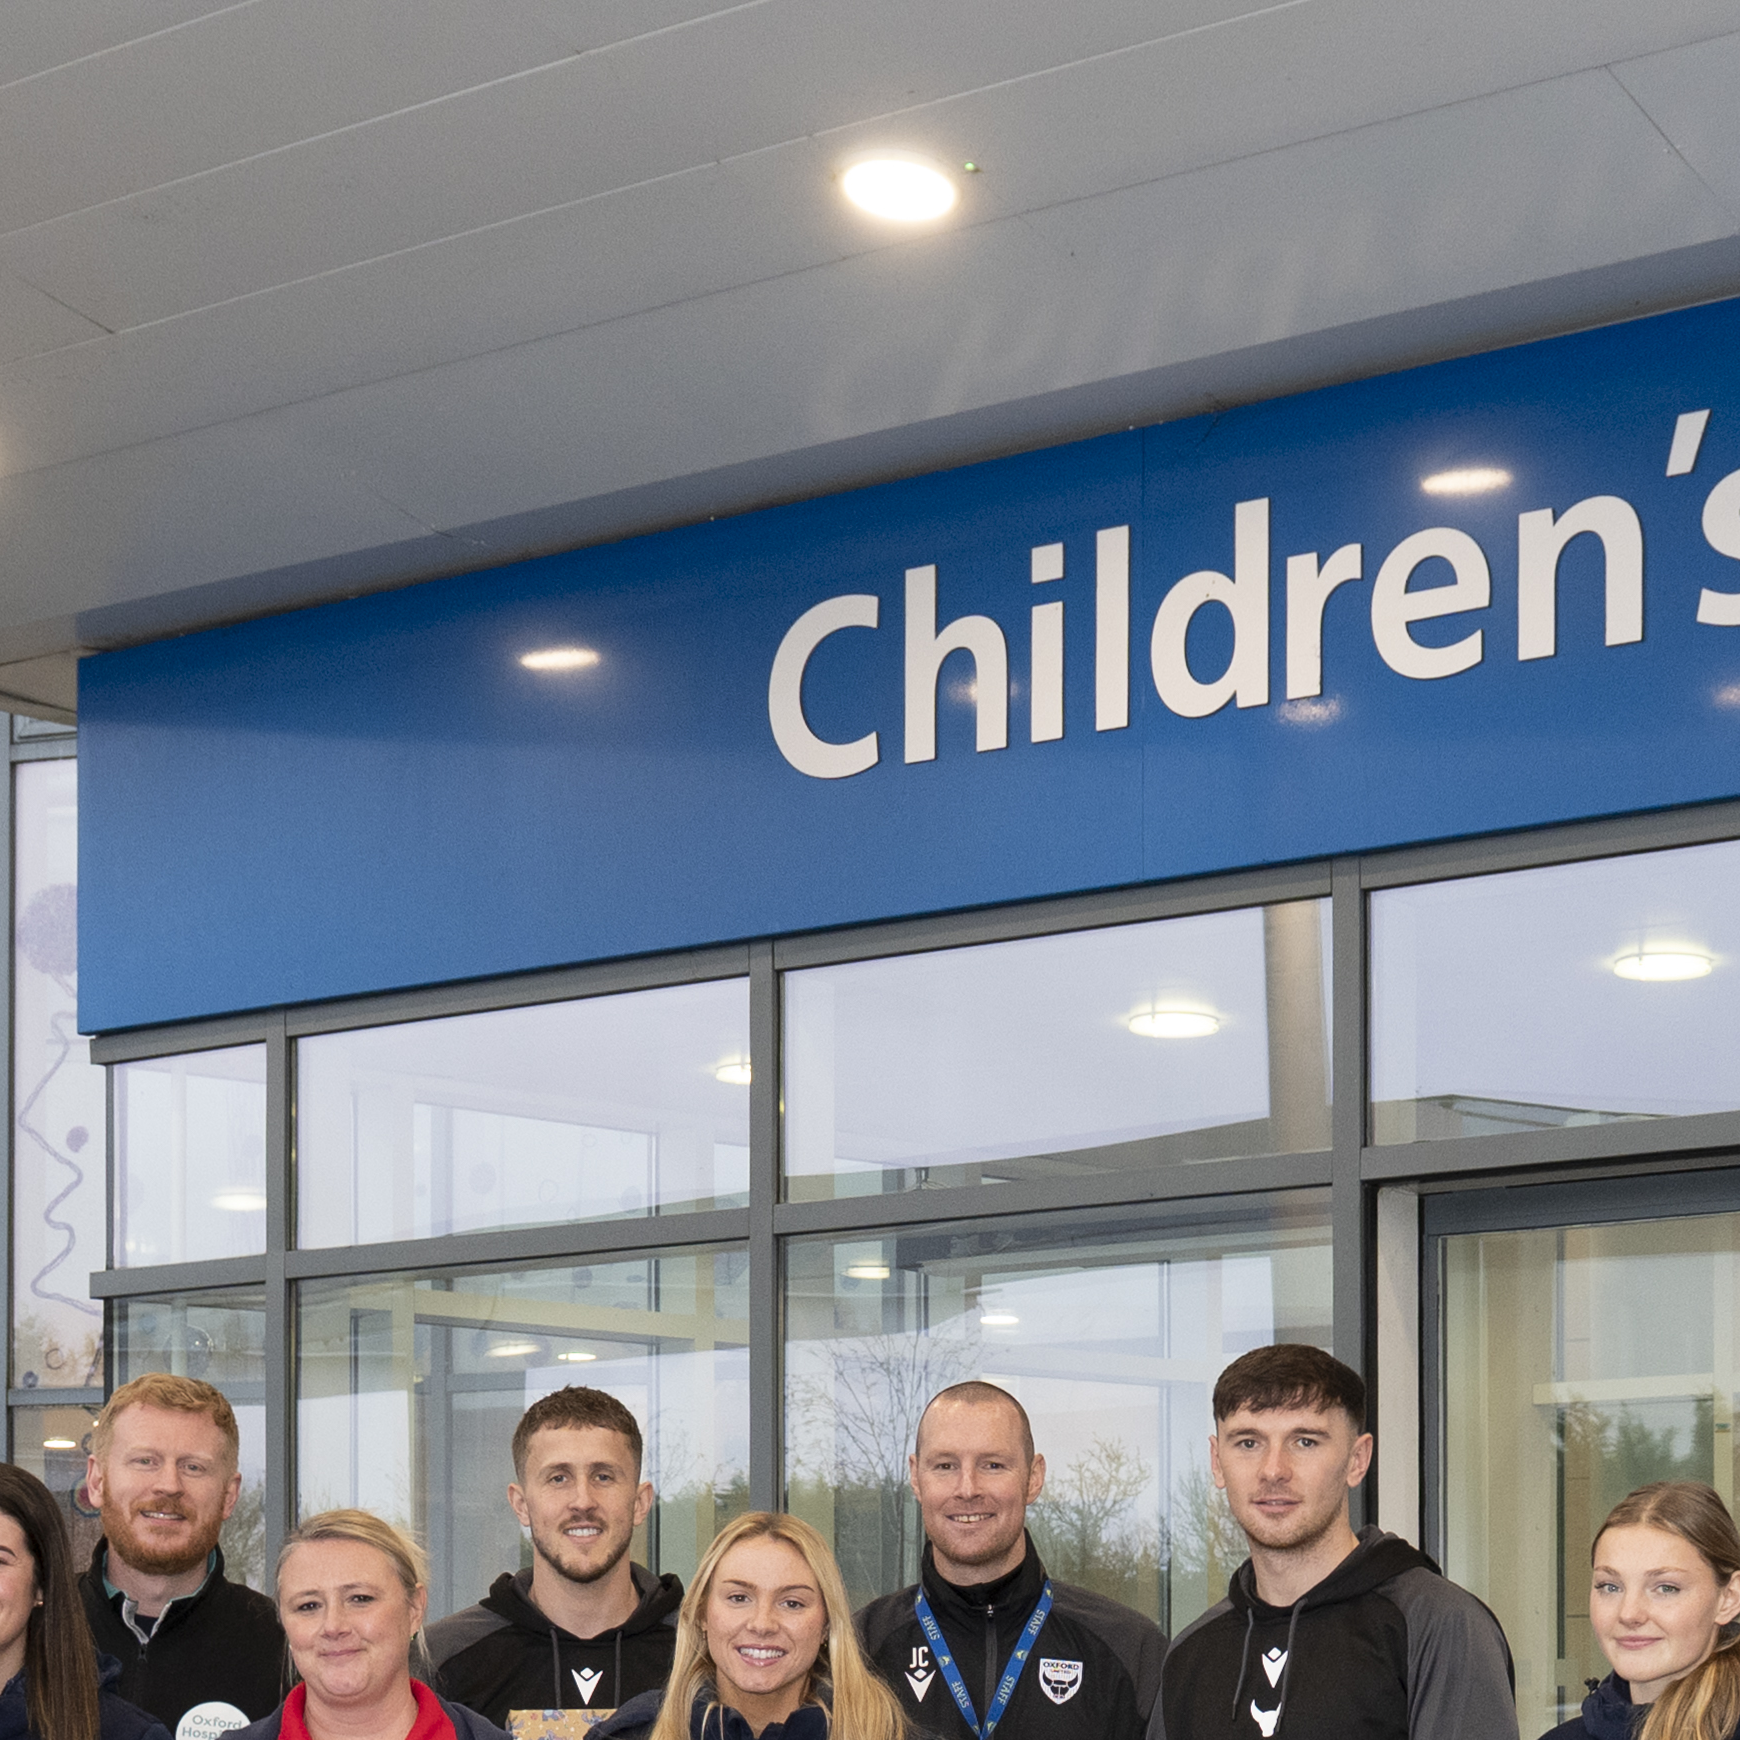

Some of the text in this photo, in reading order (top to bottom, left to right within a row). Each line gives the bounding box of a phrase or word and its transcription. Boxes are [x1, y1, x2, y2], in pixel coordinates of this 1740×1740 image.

[922, 1615, 941, 1642] STAFF
[1026, 1609, 1046, 1636] STAFF
[909, 1646, 930, 1669] JC
[951, 1680, 971, 1709] STAFF
[998, 1674, 1016, 1706] STAFF
[192, 1714, 243, 1730] Oxford
